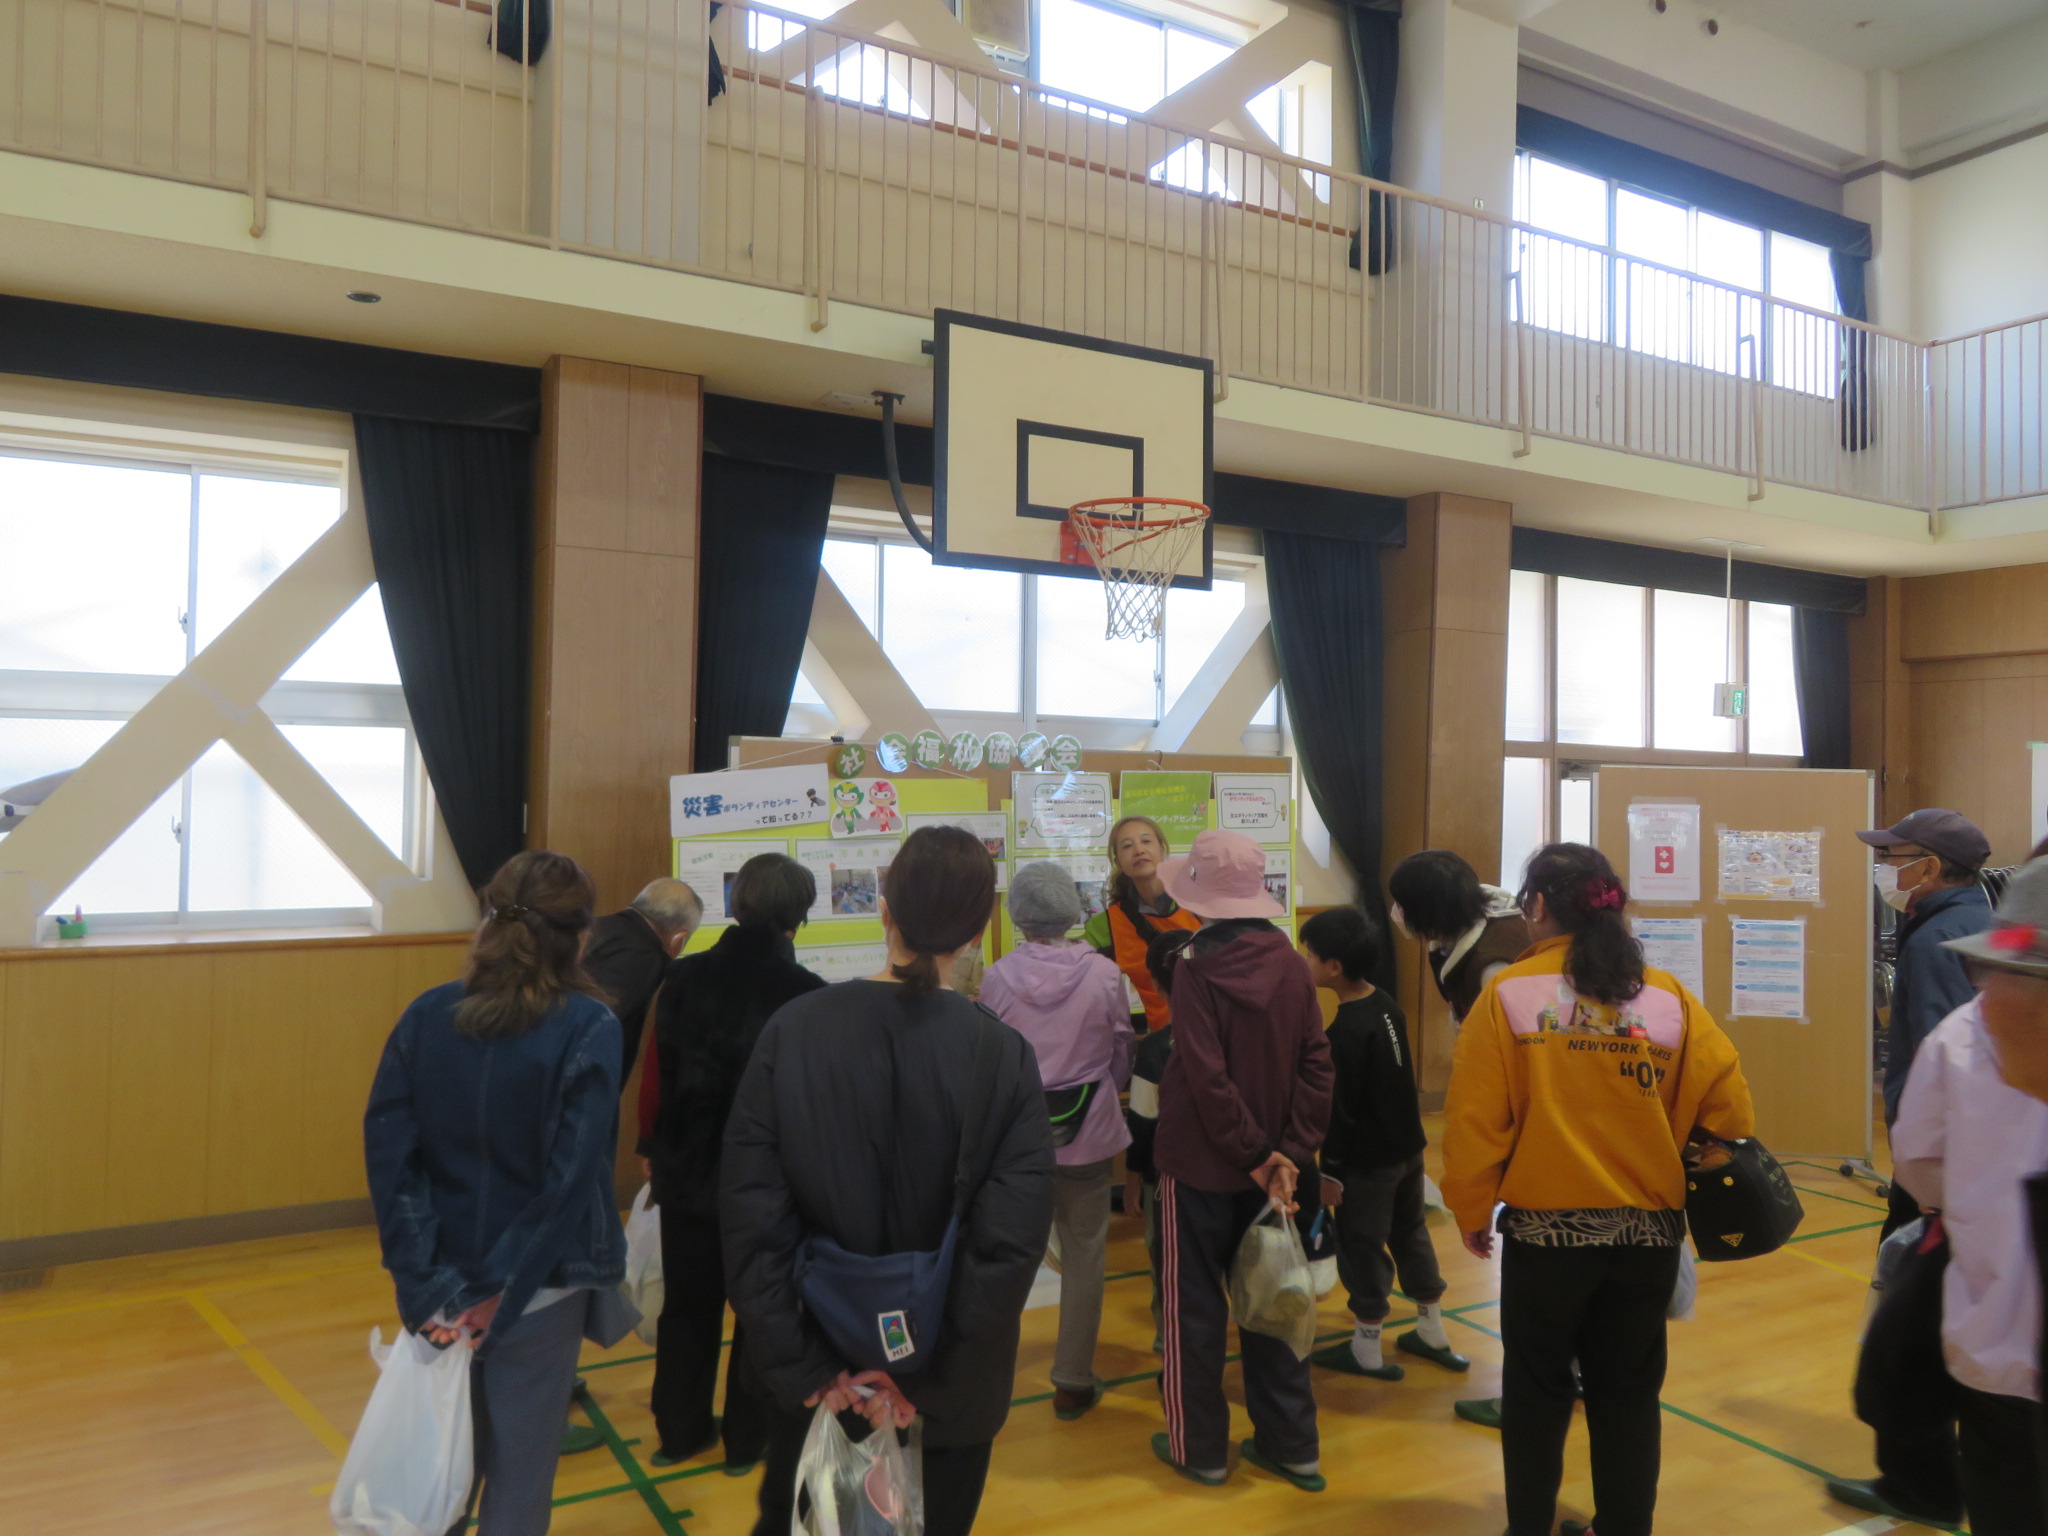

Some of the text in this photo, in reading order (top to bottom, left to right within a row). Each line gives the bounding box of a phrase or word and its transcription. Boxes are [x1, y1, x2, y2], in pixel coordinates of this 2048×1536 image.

[682, 794, 799, 819] 災害ボランティアセンター
[1647, 1045, 1673, 1061] PARIS
